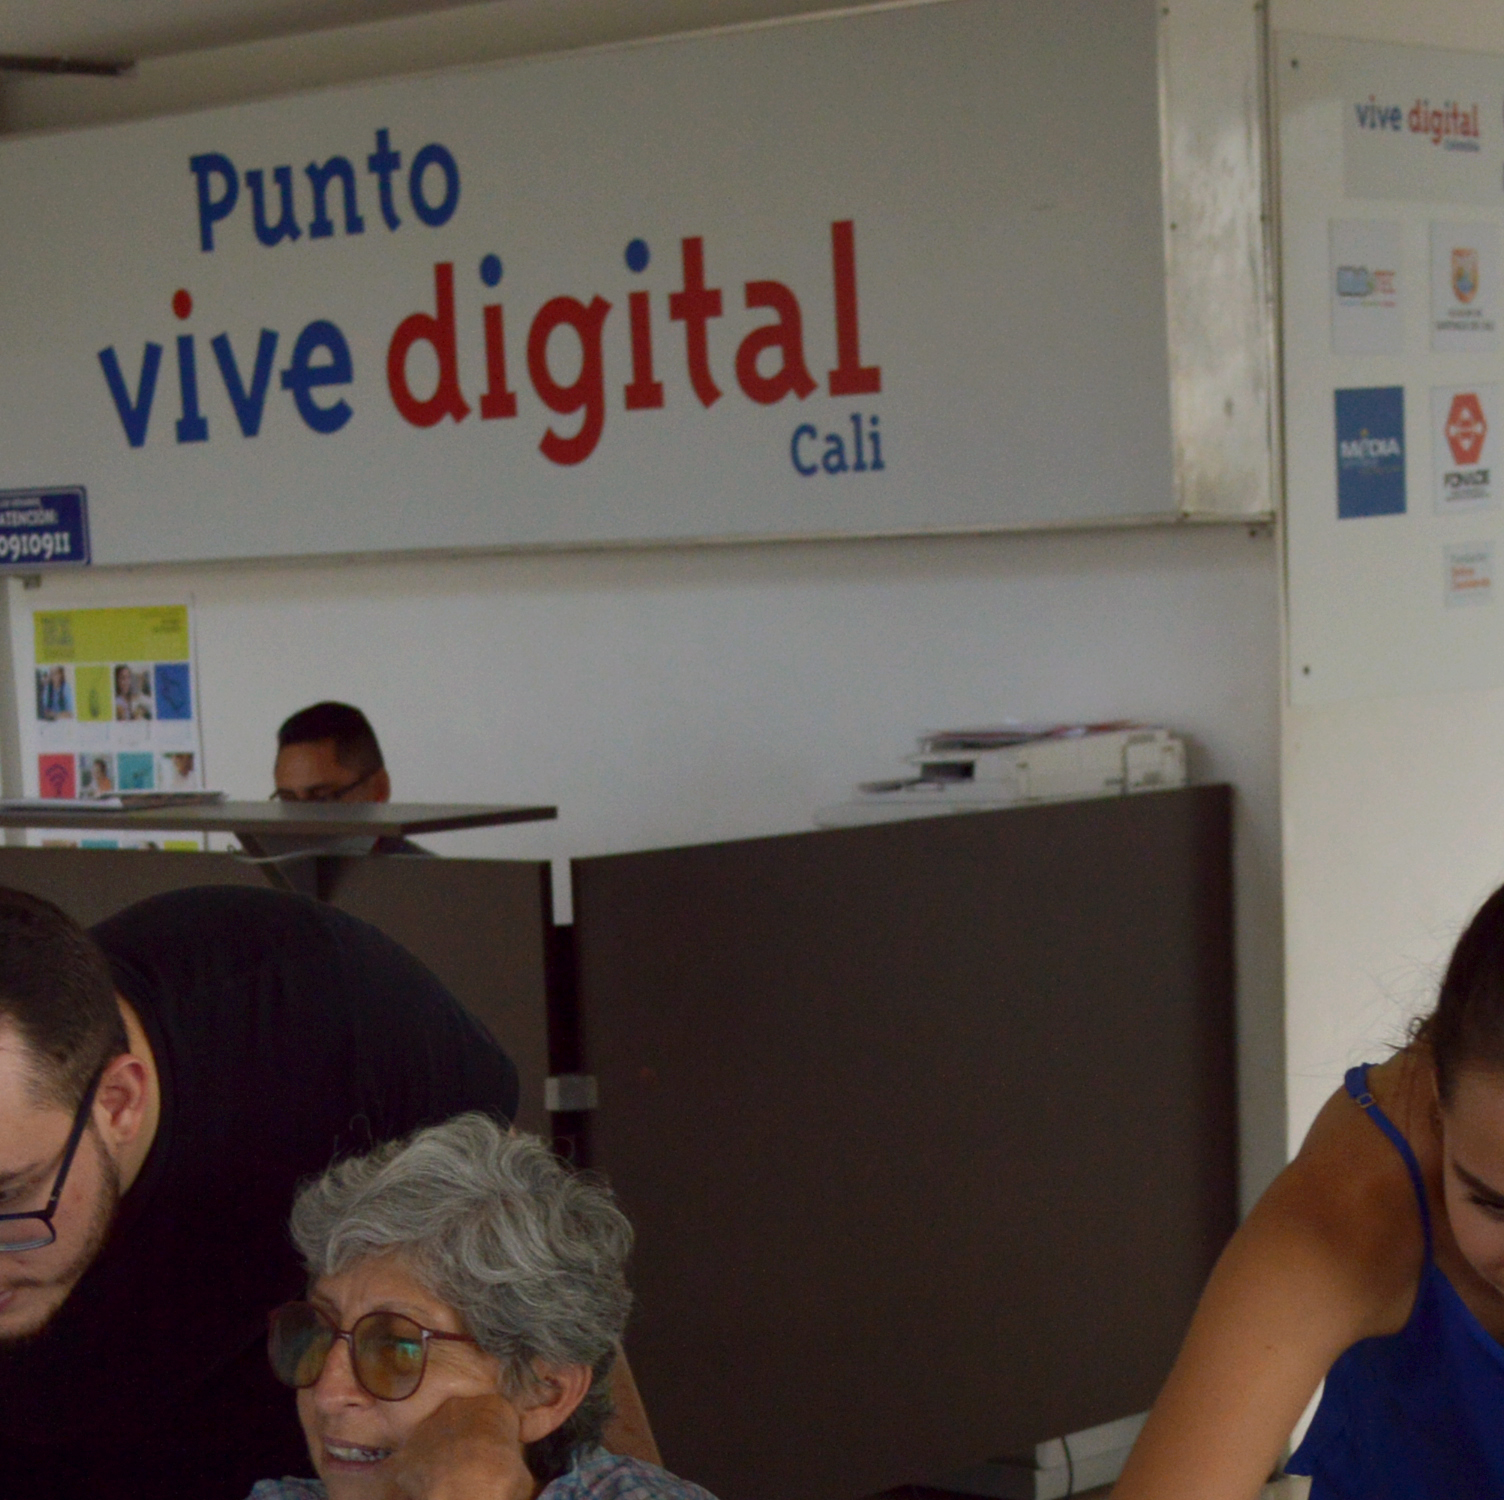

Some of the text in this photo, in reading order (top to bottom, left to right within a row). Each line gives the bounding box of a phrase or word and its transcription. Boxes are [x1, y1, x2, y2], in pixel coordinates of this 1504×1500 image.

[1355, 94, 1480, 145] vive digital
[189, 128, 461, 252] Punto
[98, 219, 882, 467] vive digital
[790, 415, 885, 476] Cali
